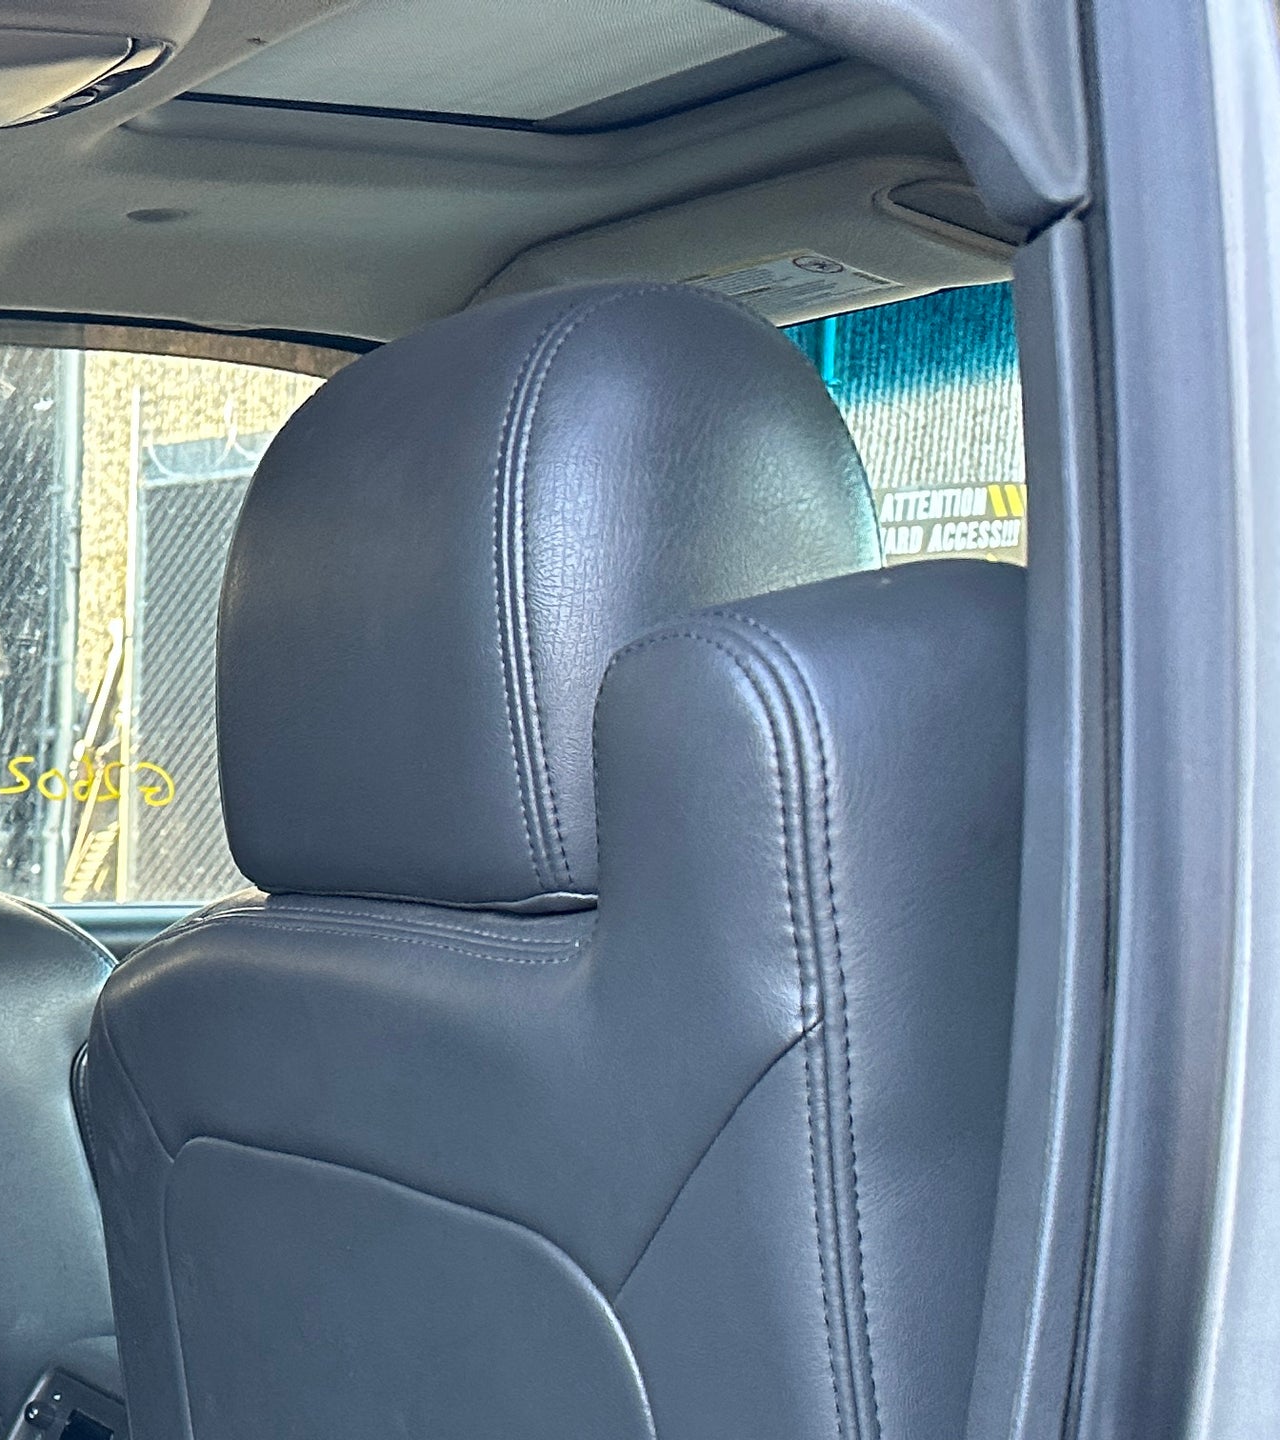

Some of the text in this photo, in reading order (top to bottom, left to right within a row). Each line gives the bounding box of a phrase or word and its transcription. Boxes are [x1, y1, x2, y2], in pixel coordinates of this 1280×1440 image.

[879, 487, 988, 523] ATTENTION
[881, 518, 1021, 555] ARD ACCESS!!!
